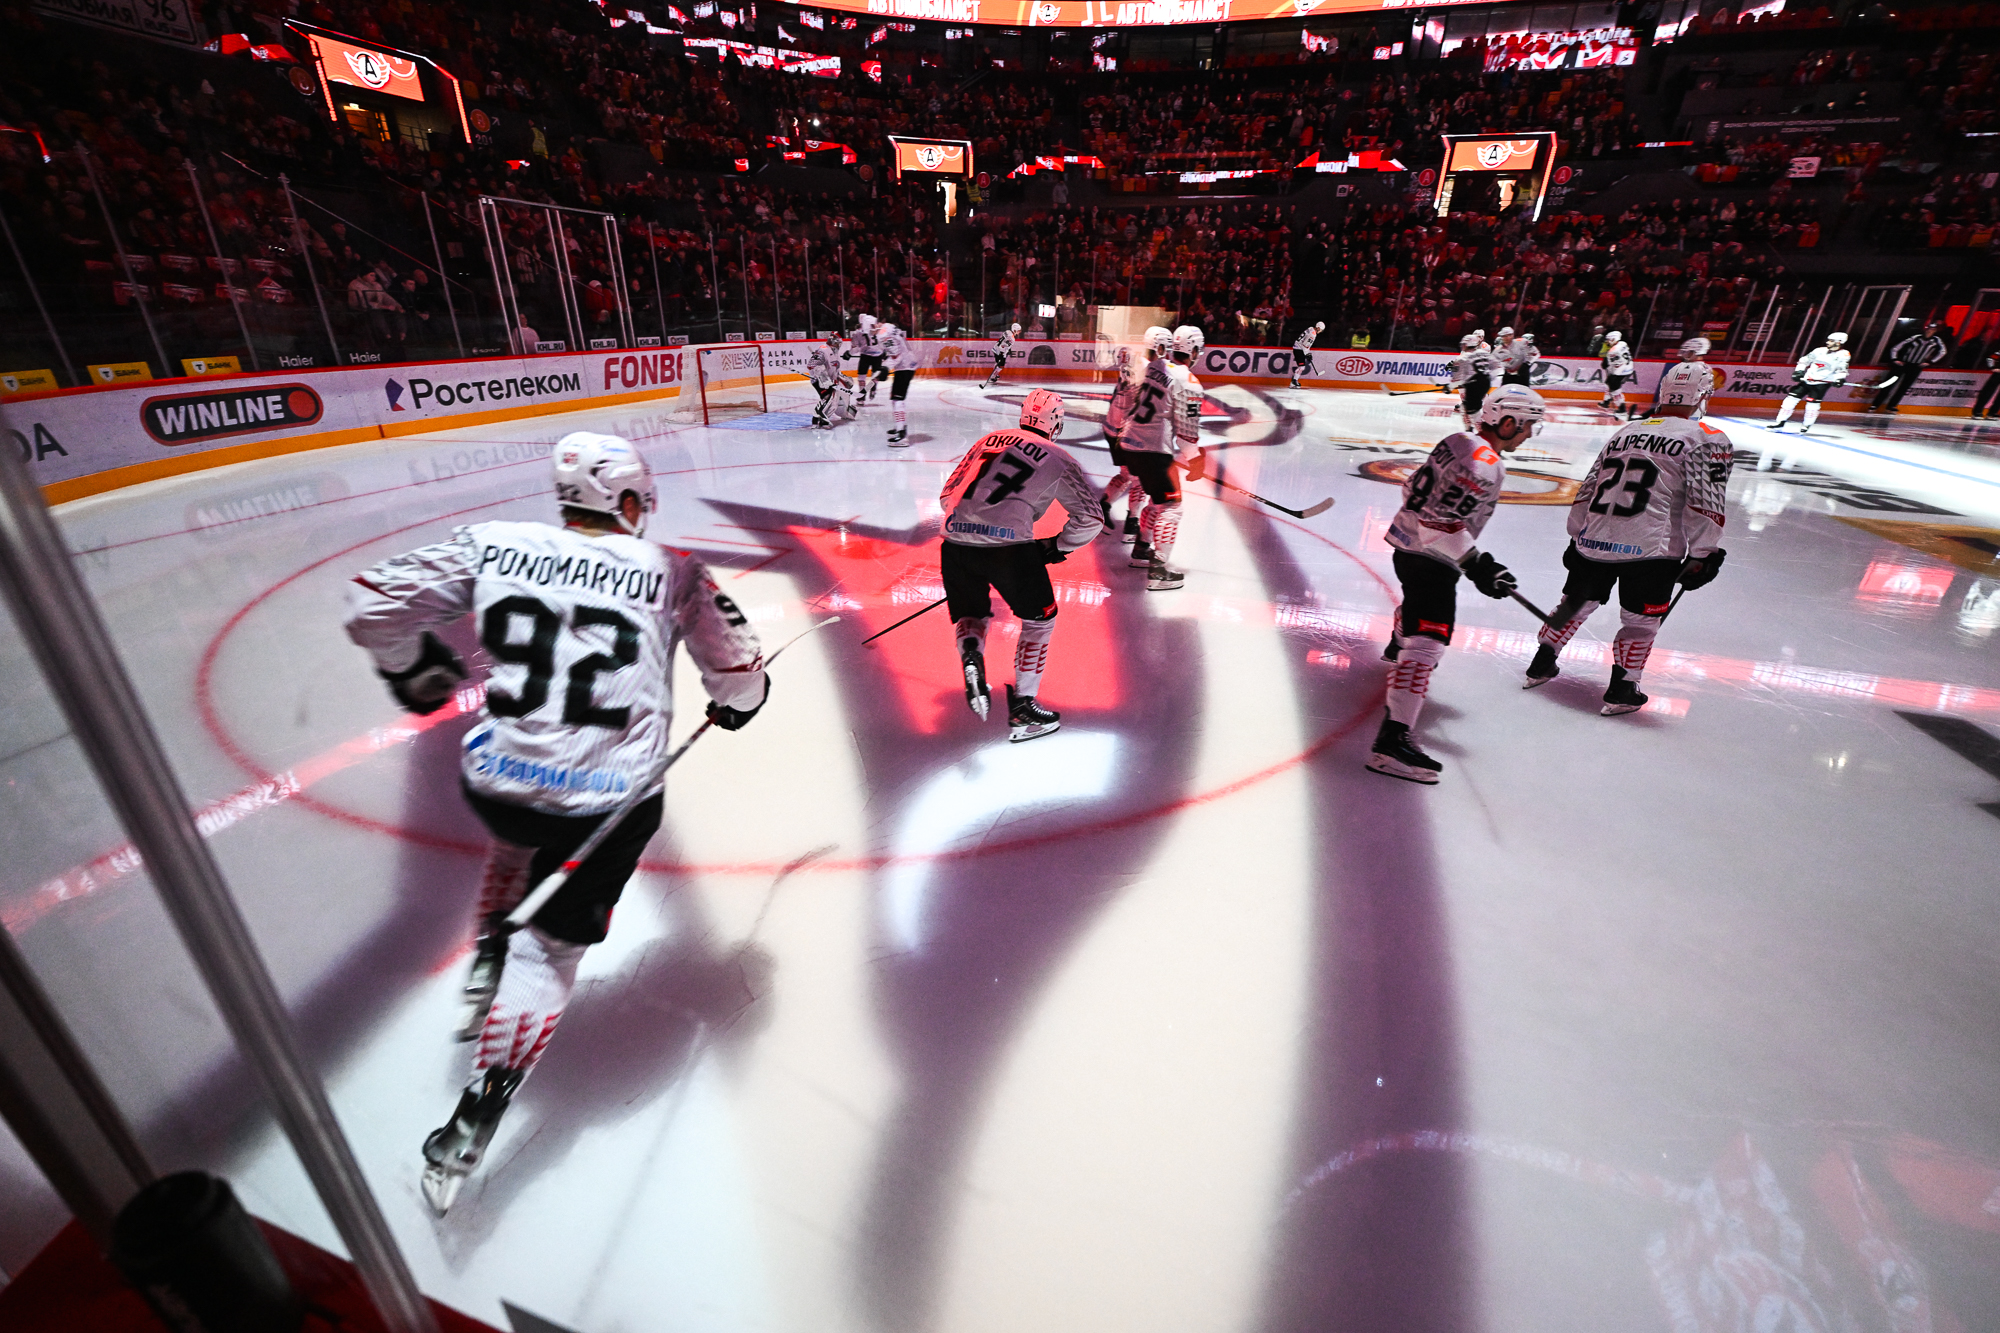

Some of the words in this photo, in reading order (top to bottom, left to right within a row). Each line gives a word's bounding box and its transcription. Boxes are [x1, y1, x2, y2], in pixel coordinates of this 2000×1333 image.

[278, 354, 314, 368] Haier
[349, 351, 381, 363] Haier
[768, 350, 794, 358] ALMA
[1574, 368, 1638, 385] LAA
[1733, 369, 1776, 380] Яндекс
[408, 372, 581, 410] Ростелеком
[1669, 394, 1684, 404] 23
[155, 394, 285, 435] WINLINE
[986, 435, 1048, 463] OKULOV
[963, 452, 1036, 505] 17
[1709, 462, 1731, 482] 2
[1589, 458, 1659, 518] 23
[1441, 486, 1477, 516] 28
[953, 522, 1015, 540] ГАЗПРОМНЕФТЬ
[478, 545, 664, 603] PONOMARYOV
[480, 595, 642, 729] 92
